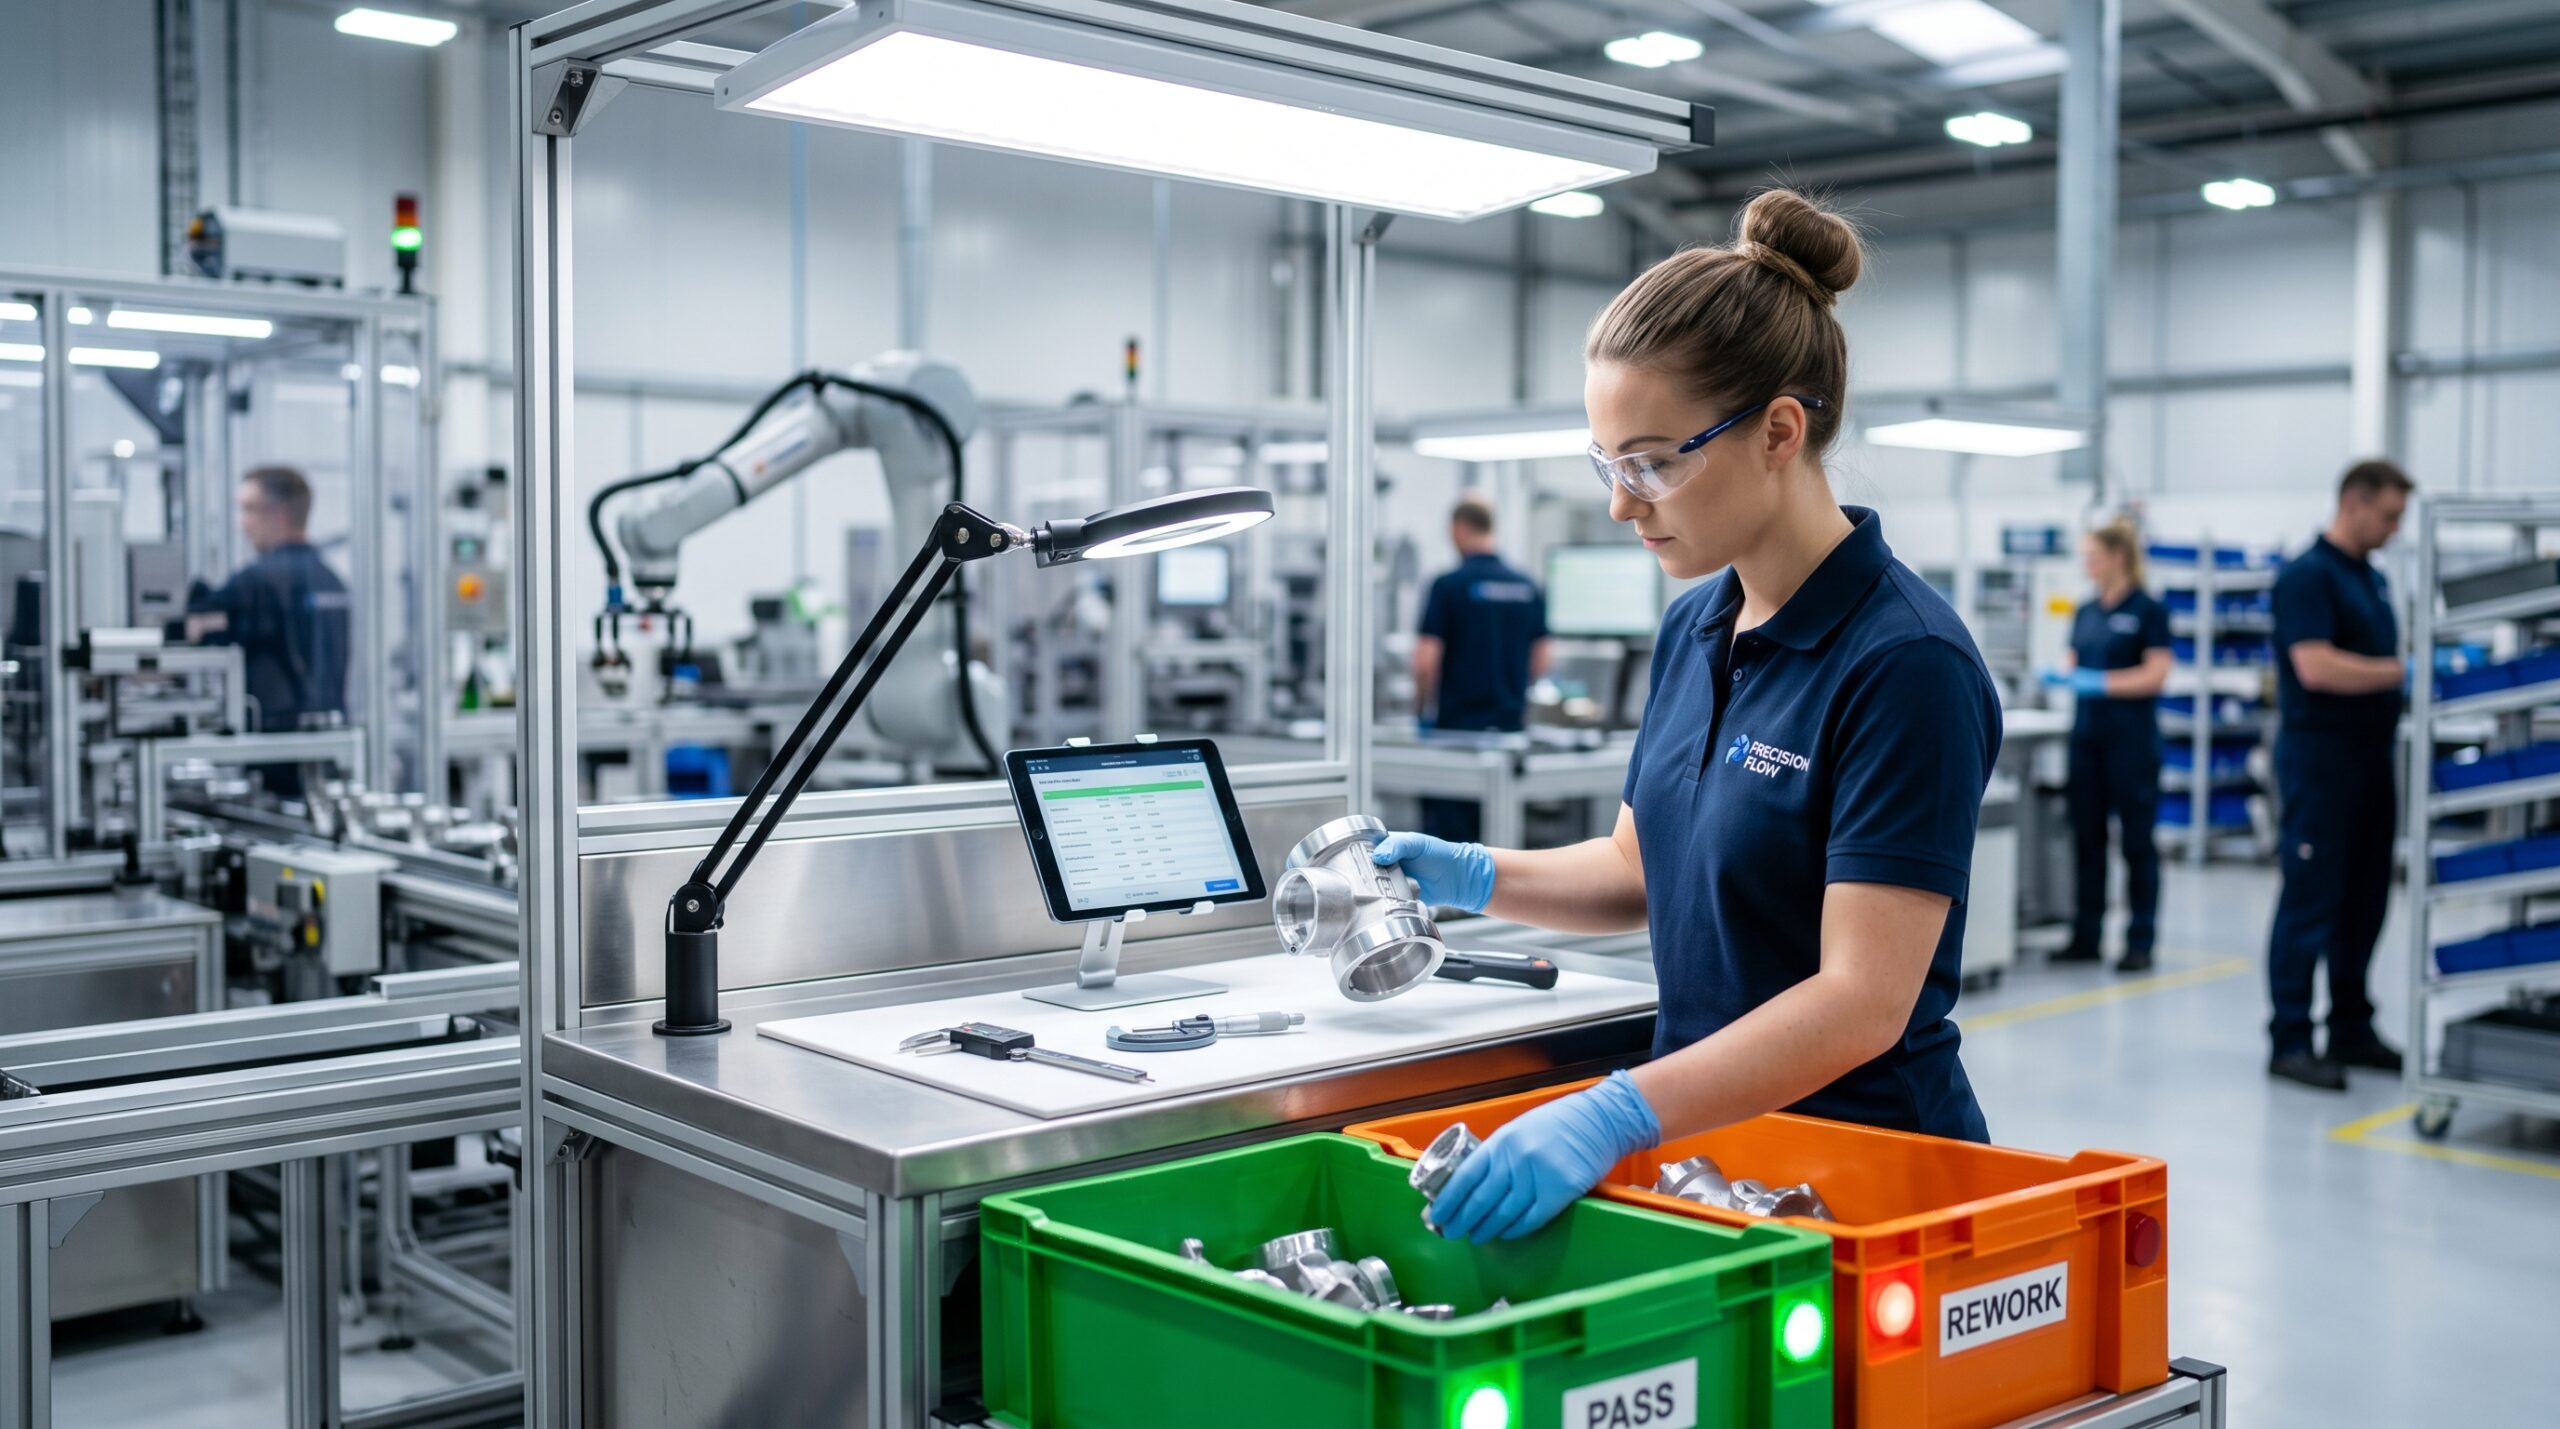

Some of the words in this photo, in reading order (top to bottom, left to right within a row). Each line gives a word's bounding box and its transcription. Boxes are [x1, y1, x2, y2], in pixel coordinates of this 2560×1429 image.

[1743, 755, 1780, 778] FLOW
[1749, 741, 1810, 772] PRECISION
[1948, 1276, 2062, 1341] REWORK
[1588, 1381, 1674, 1429] PASS
